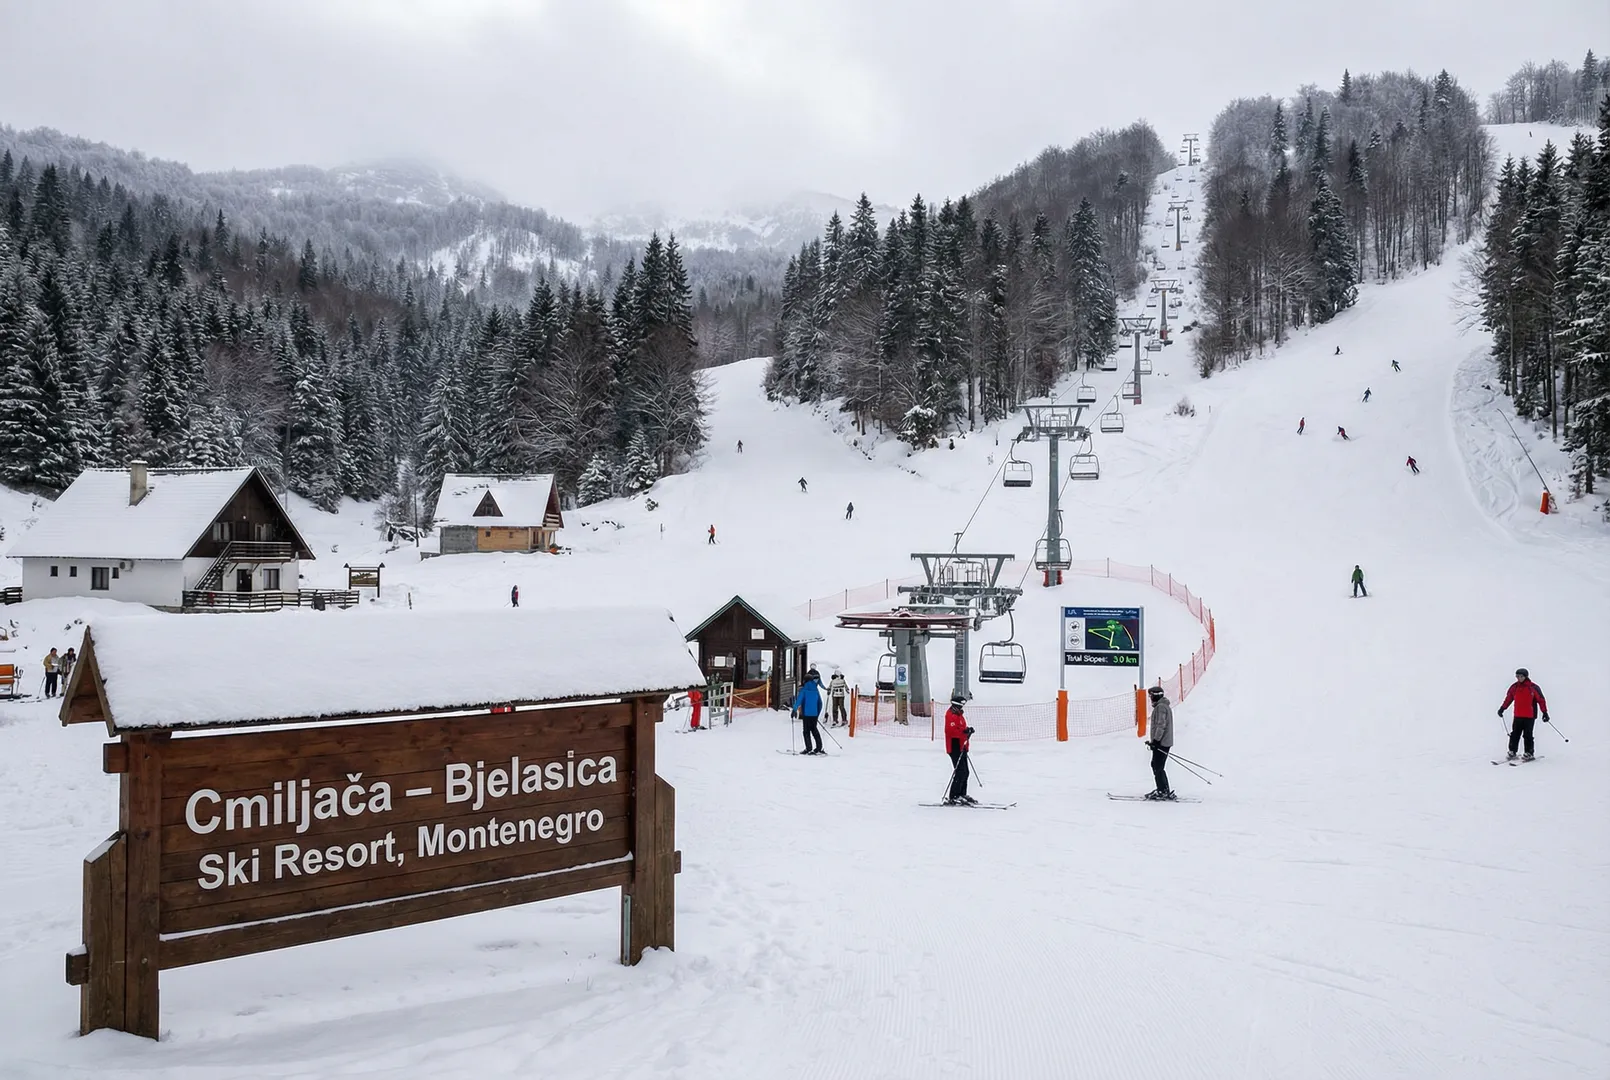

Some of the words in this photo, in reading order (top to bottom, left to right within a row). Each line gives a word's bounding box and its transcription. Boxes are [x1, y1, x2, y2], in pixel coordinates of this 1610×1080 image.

[186, 771, 392, 834] Cmiljača
[446, 750, 617, 810] Bjelasica
[198, 848, 260, 890] Ski
[275, 832, 405, 878] Resort,
[419, 809, 604, 858] Montenegro
